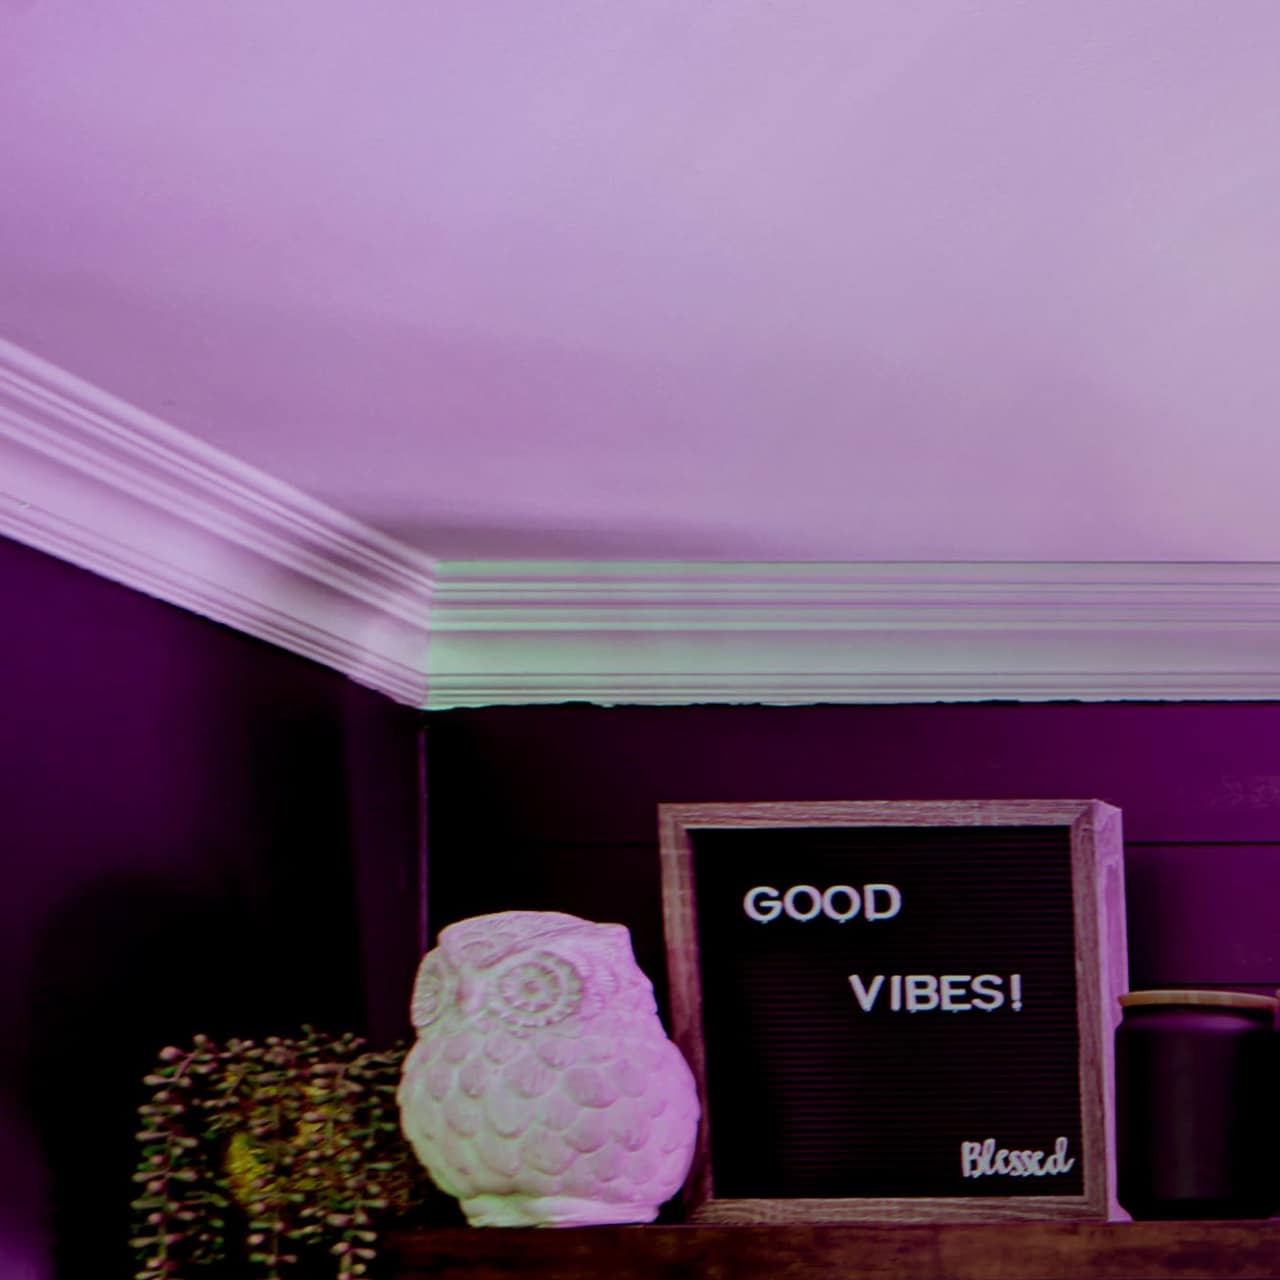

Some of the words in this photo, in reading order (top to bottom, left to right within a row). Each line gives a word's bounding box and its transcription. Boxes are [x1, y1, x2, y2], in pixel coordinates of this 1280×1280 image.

[743, 884, 902, 923] GOOD
[848, 974, 1023, 1013] VIBES!
[961, 1137, 1075, 1178] Blessed
